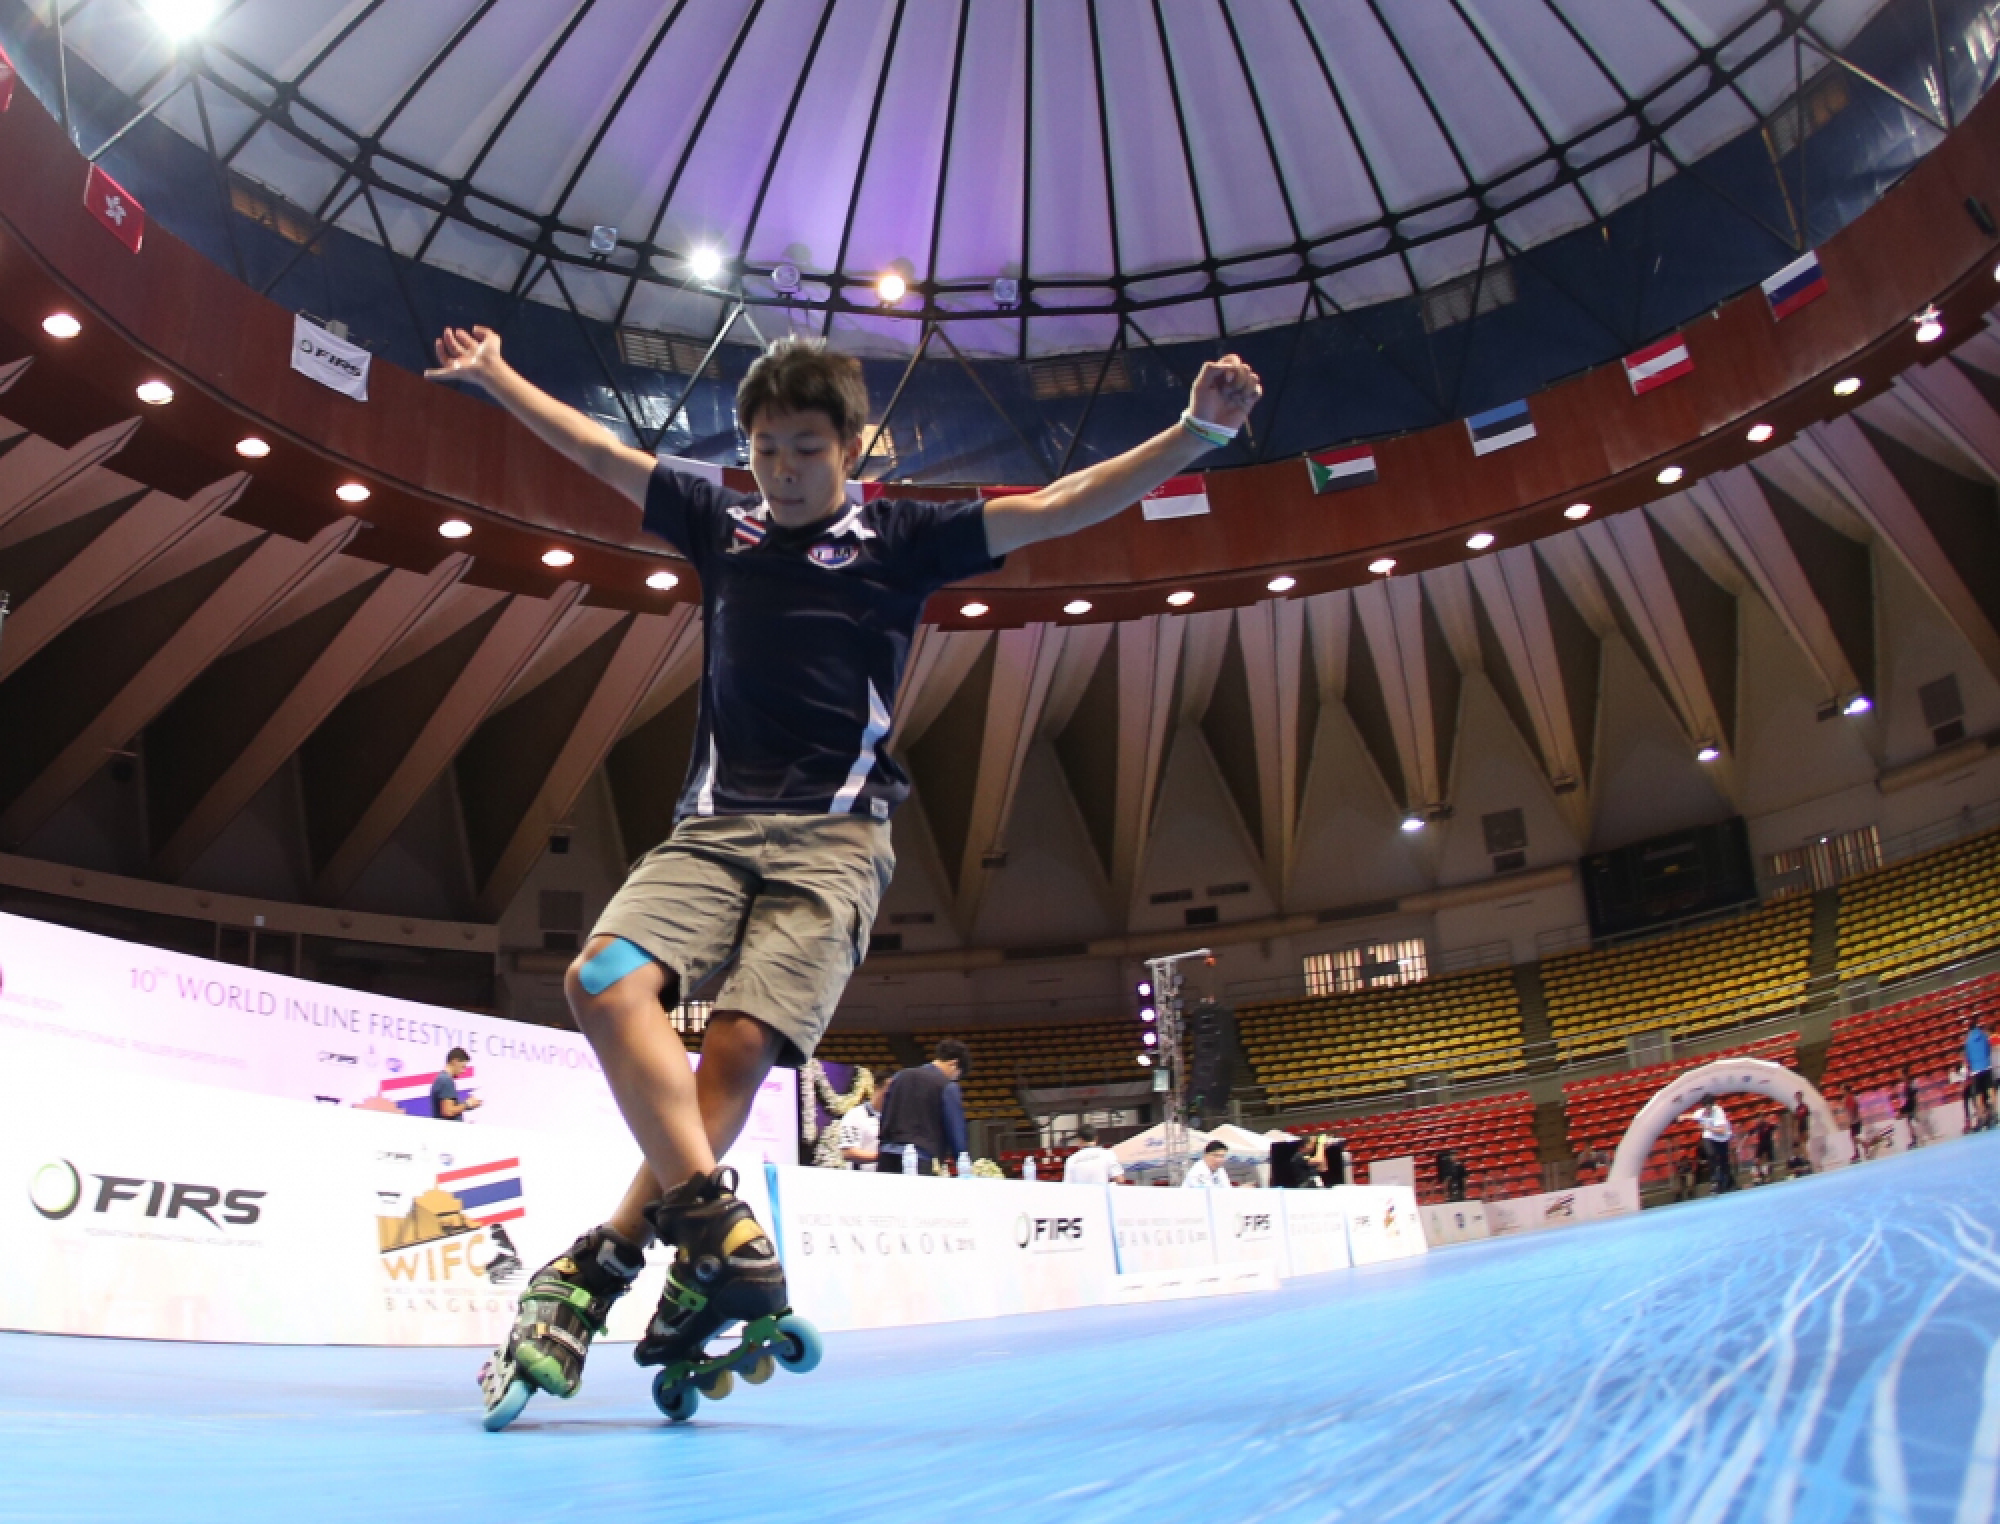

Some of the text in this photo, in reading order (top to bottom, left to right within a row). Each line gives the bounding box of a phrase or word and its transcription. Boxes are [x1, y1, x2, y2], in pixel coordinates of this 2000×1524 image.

[176, 973, 277, 1017] WORLD
[284, 996, 361, 1033] INLINE
[368, 1012, 478, 1053] FREESTYLE
[90, 1173, 268, 1232] FIRS
[801, 1231, 954, 1256] BANGKOK
[1032, 1217, 1084, 1242] FIRS
[378, 1233, 486, 1282] WIFC
